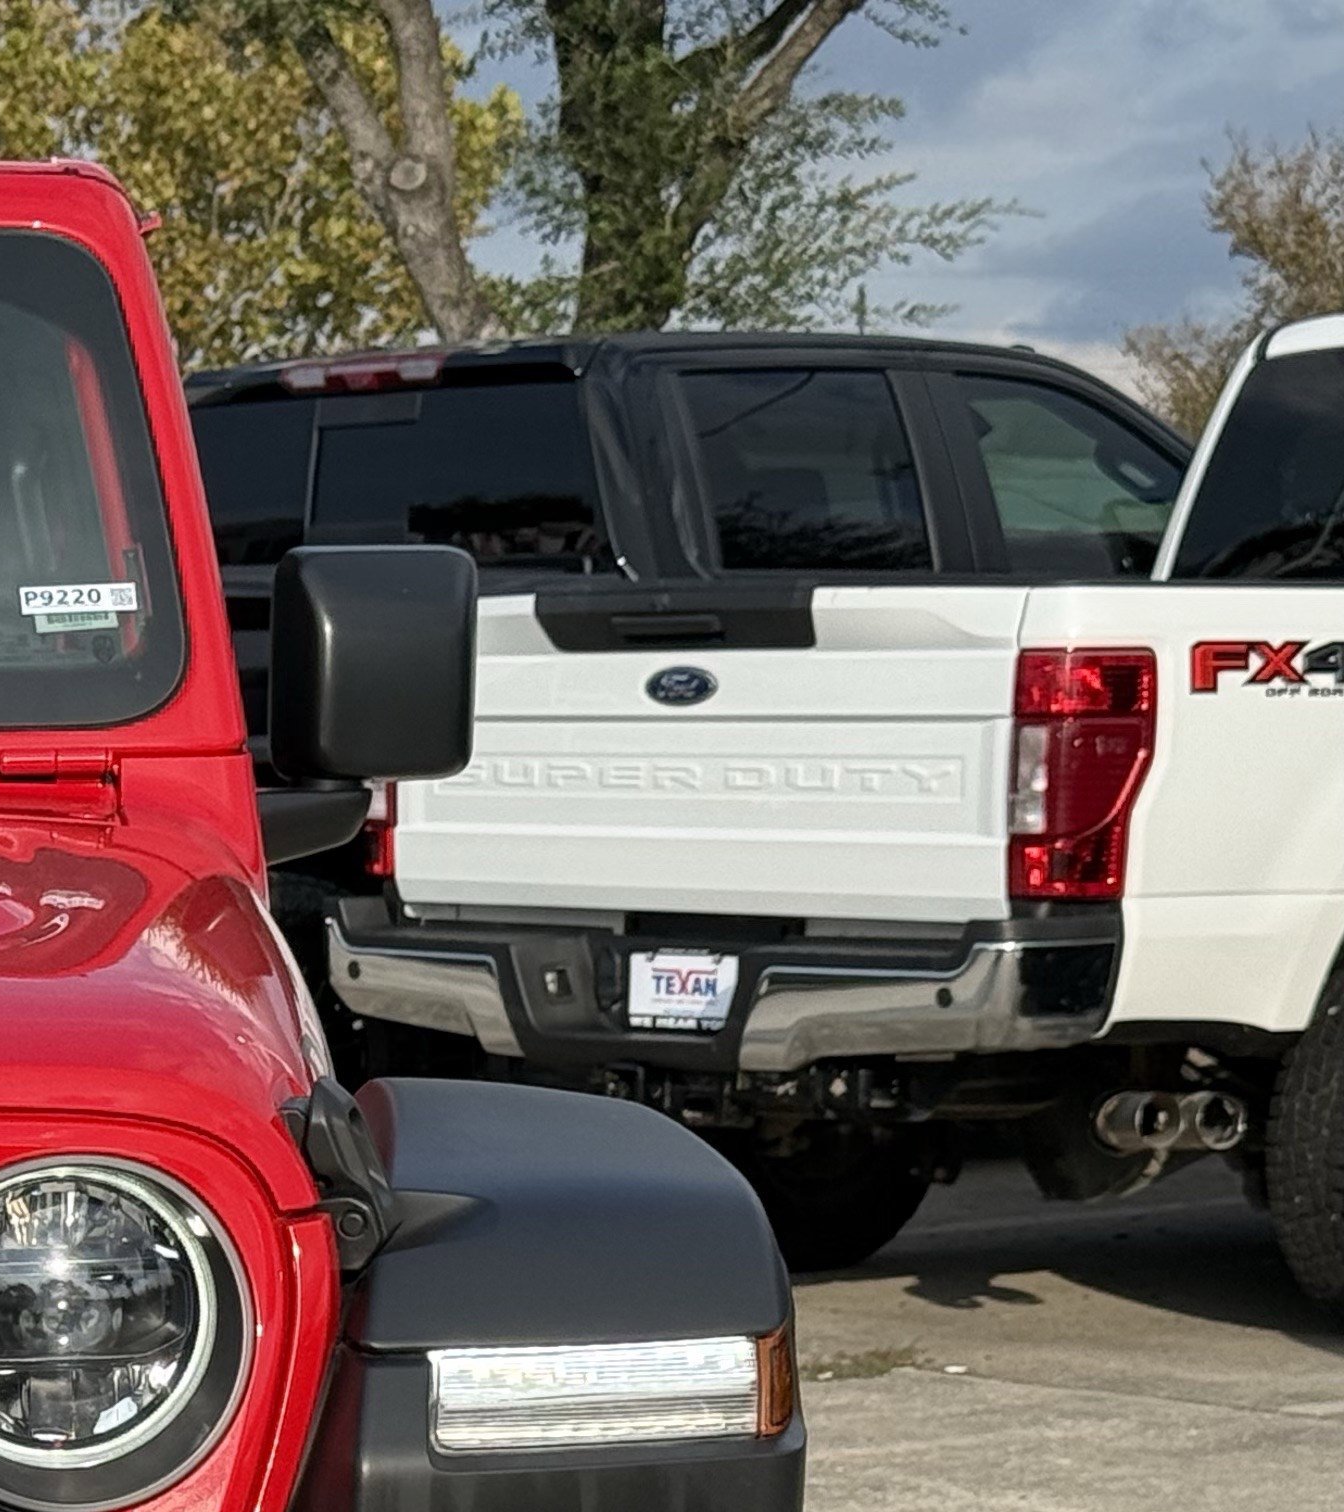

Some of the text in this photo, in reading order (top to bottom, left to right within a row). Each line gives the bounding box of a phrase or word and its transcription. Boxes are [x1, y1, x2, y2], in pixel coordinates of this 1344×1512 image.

[23, 587, 102, 607] P9220
[1190, 641, 1344, 693] FX4
[1308, 688, 1344, 697] ROA
[723, 761, 957, 794] DUTY
[651, 969, 718, 997] TEXAN
